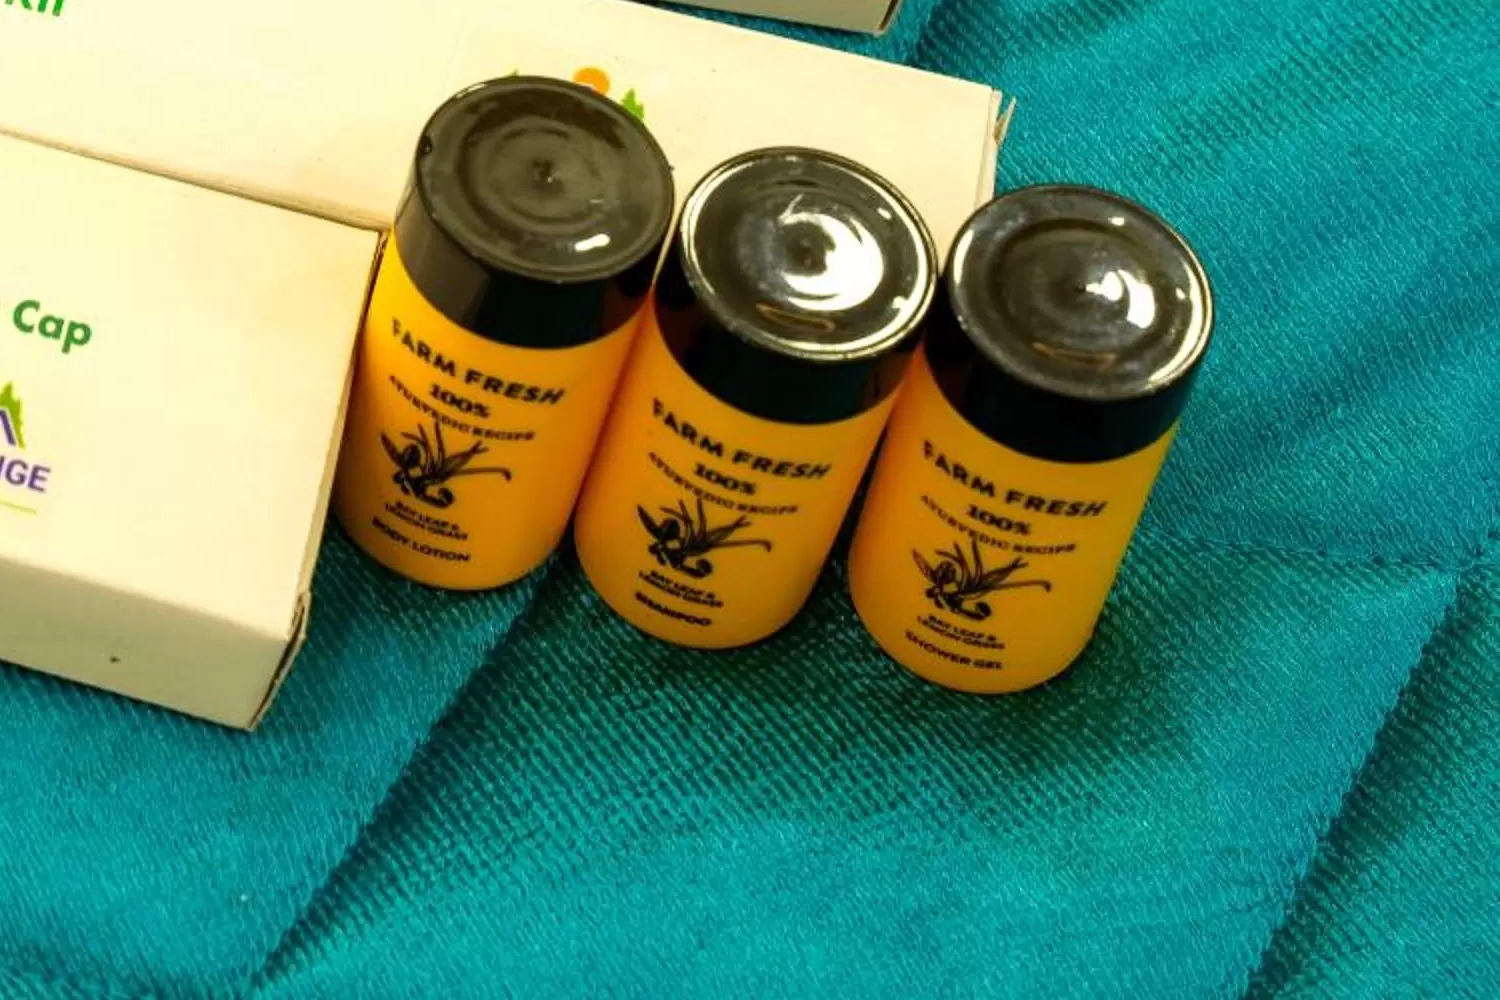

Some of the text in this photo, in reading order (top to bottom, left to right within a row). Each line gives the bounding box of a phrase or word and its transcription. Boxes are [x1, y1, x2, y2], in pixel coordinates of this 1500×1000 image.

[12, 299, 93, 354] Cap
[392, 317, 565, 405] FARM FRESH
[428, 383, 491, 418] 100%
[653, 398, 832, 479] FARM FRESH
[693, 463, 756, 496] 100%
[924, 440, 1108, 517] FARM FRESH
[967, 504, 1031, 536] 100%
[412, 541, 470, 562] LOTION
[905, 629, 971, 666] SHOWER
